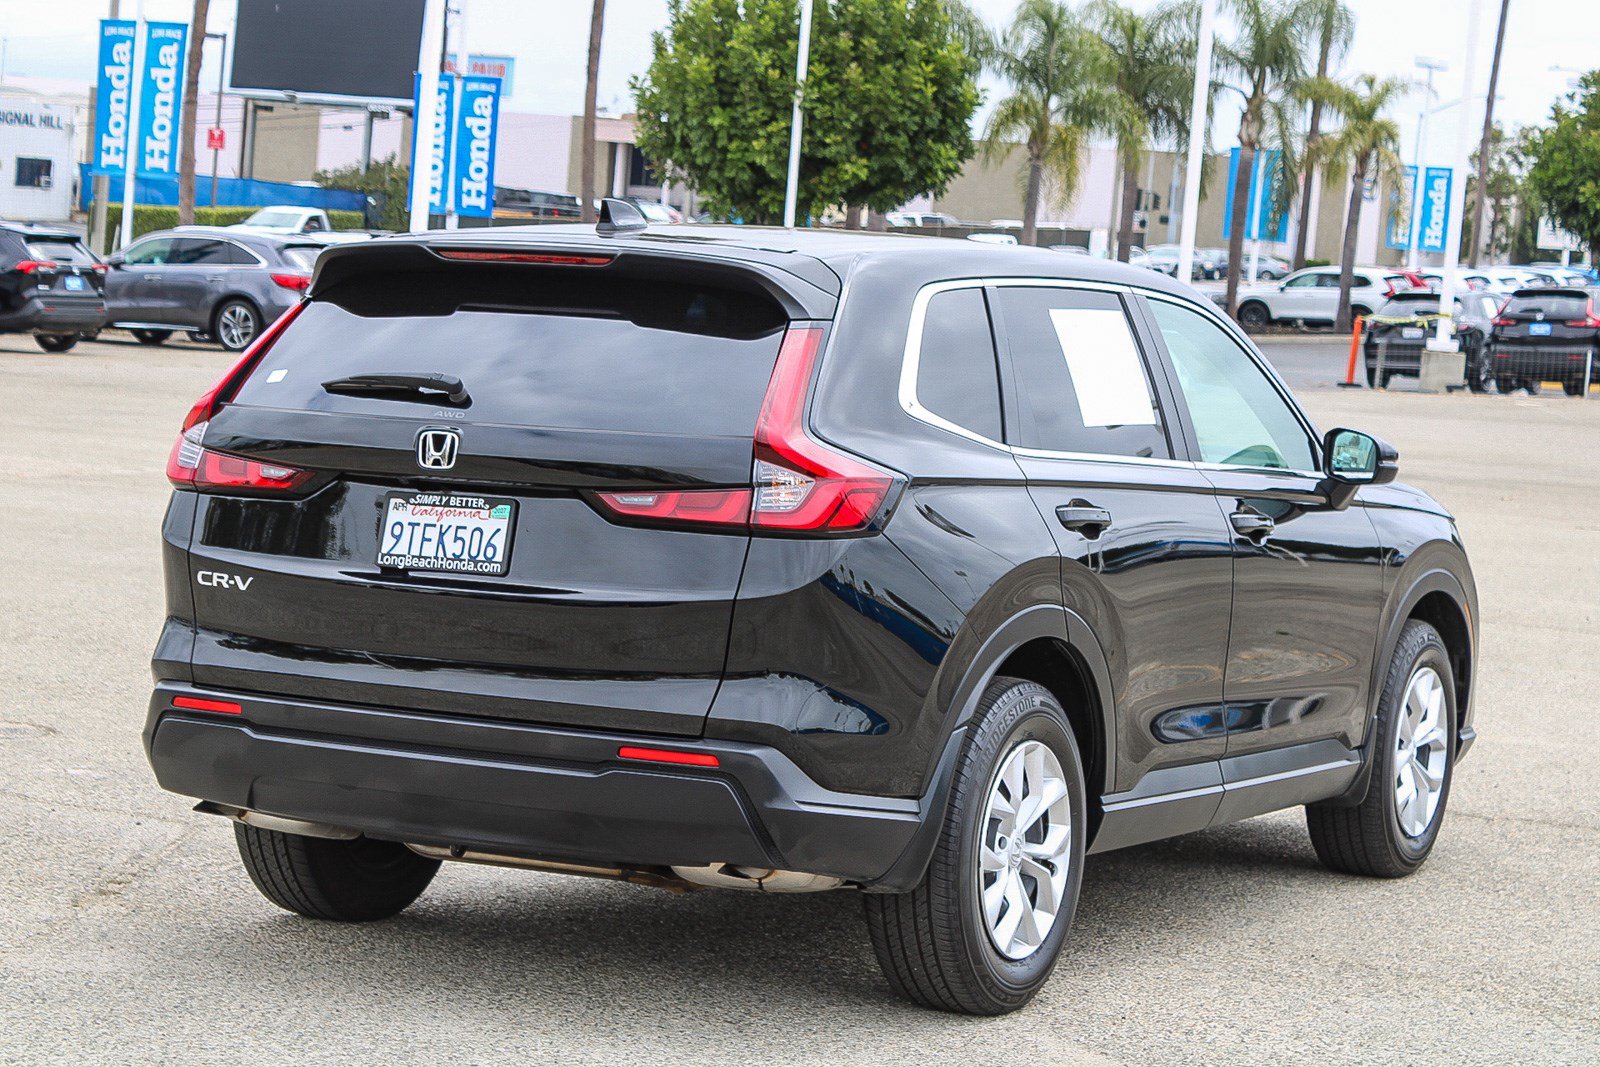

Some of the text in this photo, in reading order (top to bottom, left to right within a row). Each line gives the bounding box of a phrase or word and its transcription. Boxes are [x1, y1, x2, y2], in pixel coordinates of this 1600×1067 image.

[101, 39, 132, 169] Honda
[145, 42, 180, 173] Honda
[40, 115, 64, 130] HILL
[461, 95, 494, 211] Honda
[1424, 177, 1448, 249] Honda
[434, 410, 466, 419] AWD
[414, 494, 485, 508] SIMPLY BETTER
[411, 504, 490, 522] California
[377, 551, 501, 573] LongBeachHonda.com
[196, 570, 254, 591] CR-V
